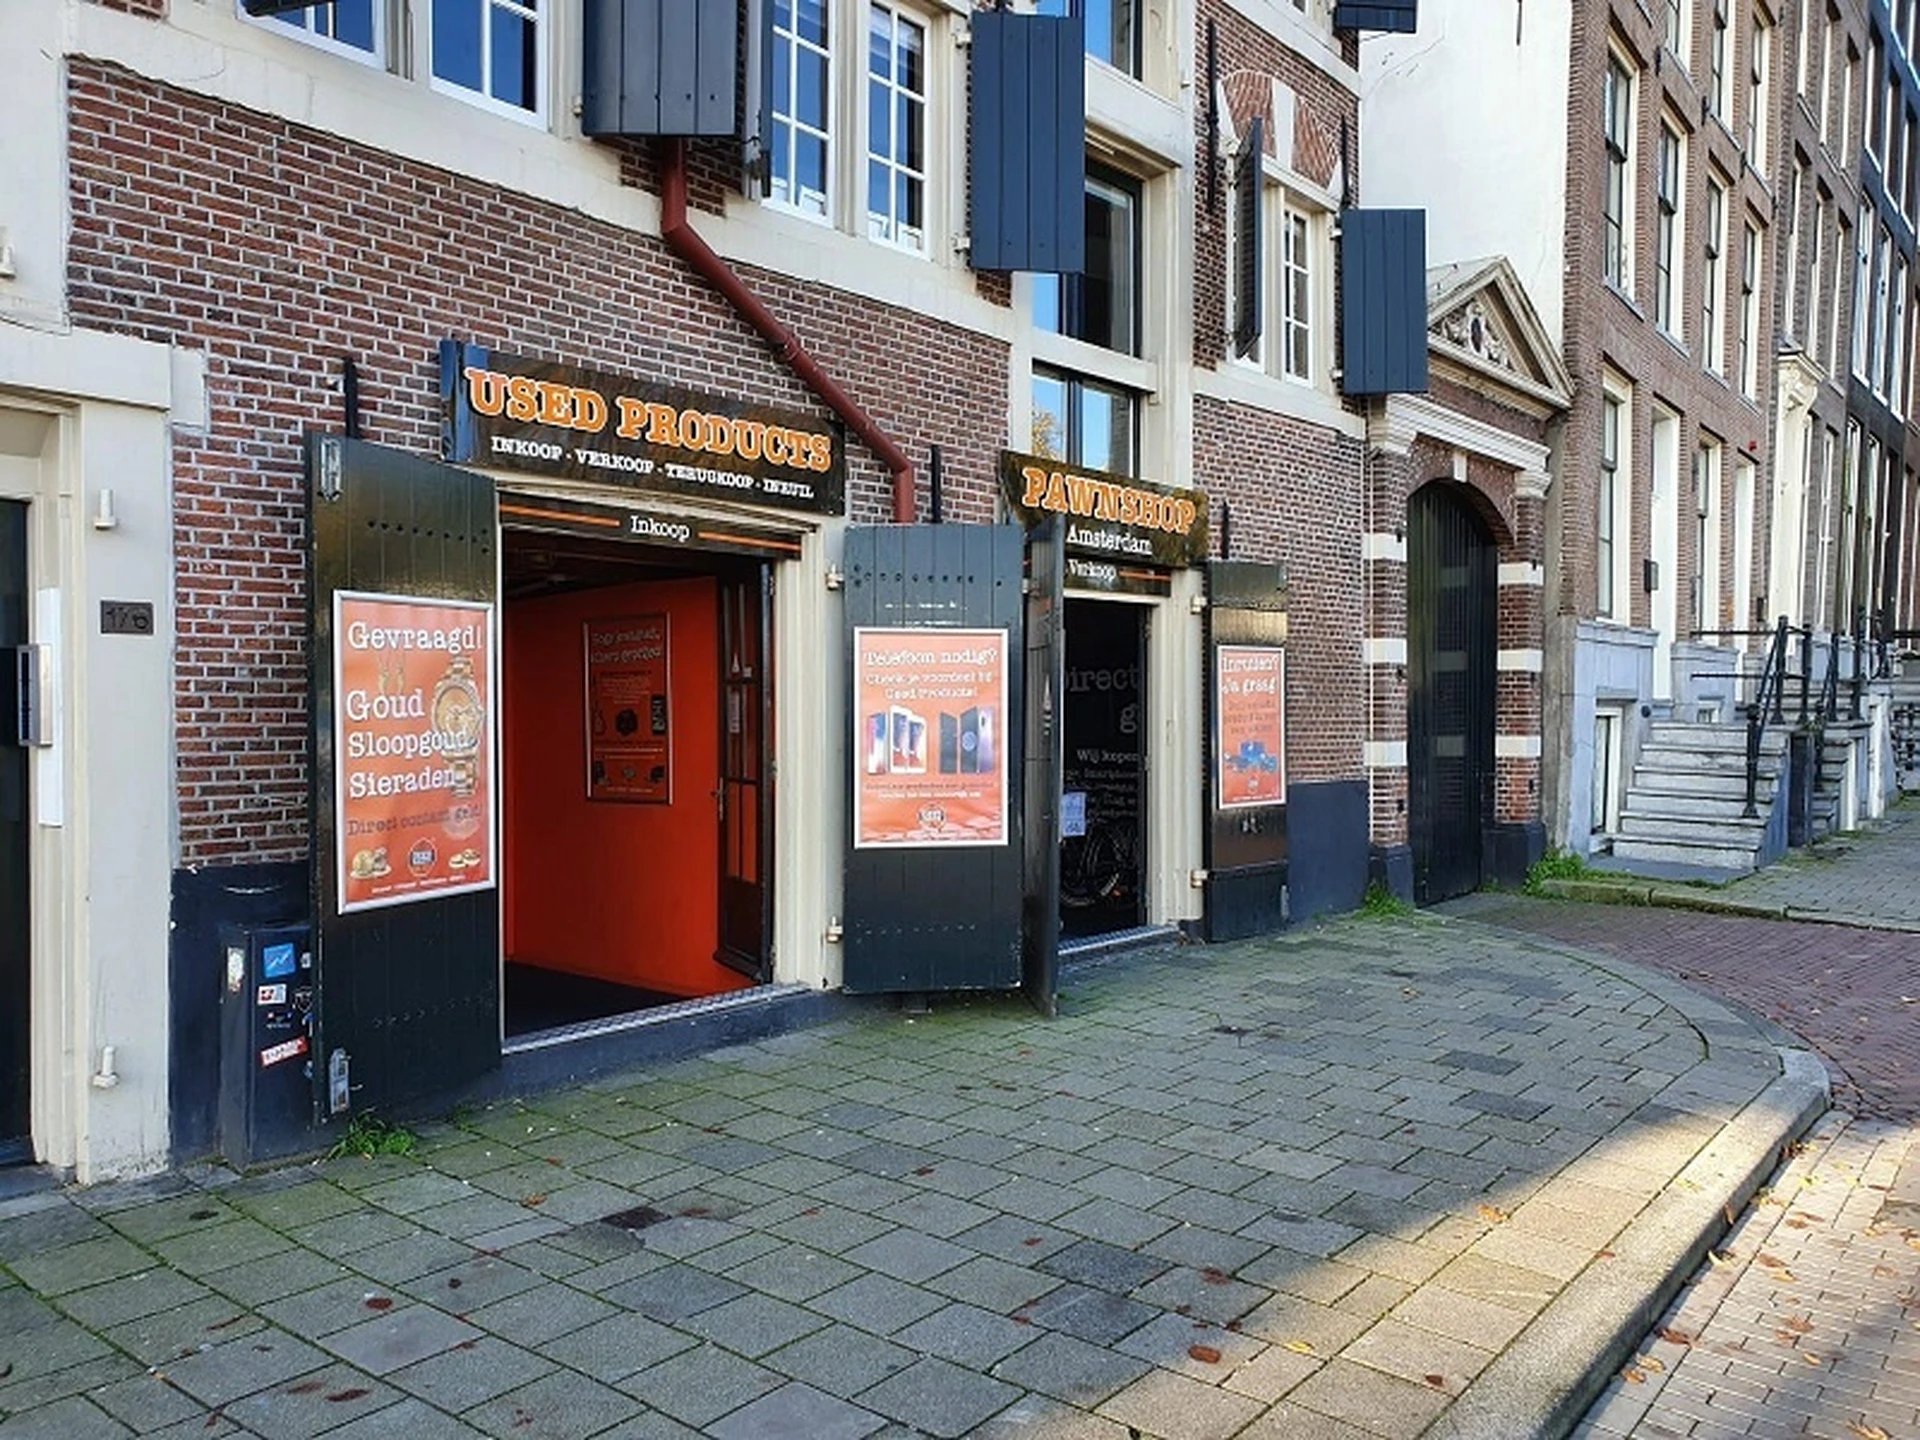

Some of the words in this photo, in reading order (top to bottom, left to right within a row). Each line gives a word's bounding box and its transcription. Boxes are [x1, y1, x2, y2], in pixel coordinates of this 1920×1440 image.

[464, 367, 607, 434] USED
[615, 396, 832, 473] PRODUCTS
[490, 436, 563, 461] INKOOP
[575, 449, 655, 474] VERKOOP
[666, 463, 754, 490] TERUGKOOP
[1022, 467, 1197, 534] PAWNSHOP
[630, 514, 691, 542] Inkoop
[1066, 523, 1153, 556] Amsterdam
[1067, 558, 1117, 583] Verkoop
[348, 621, 483, 655] Gevraagd!
[1065, 662, 1138, 693] irect
[346, 688, 424, 722] Goud
[348, 727, 471, 759] Sloopgoud
[349, 768, 457, 799] Sieraden
[347, 818, 398, 836] Direct
